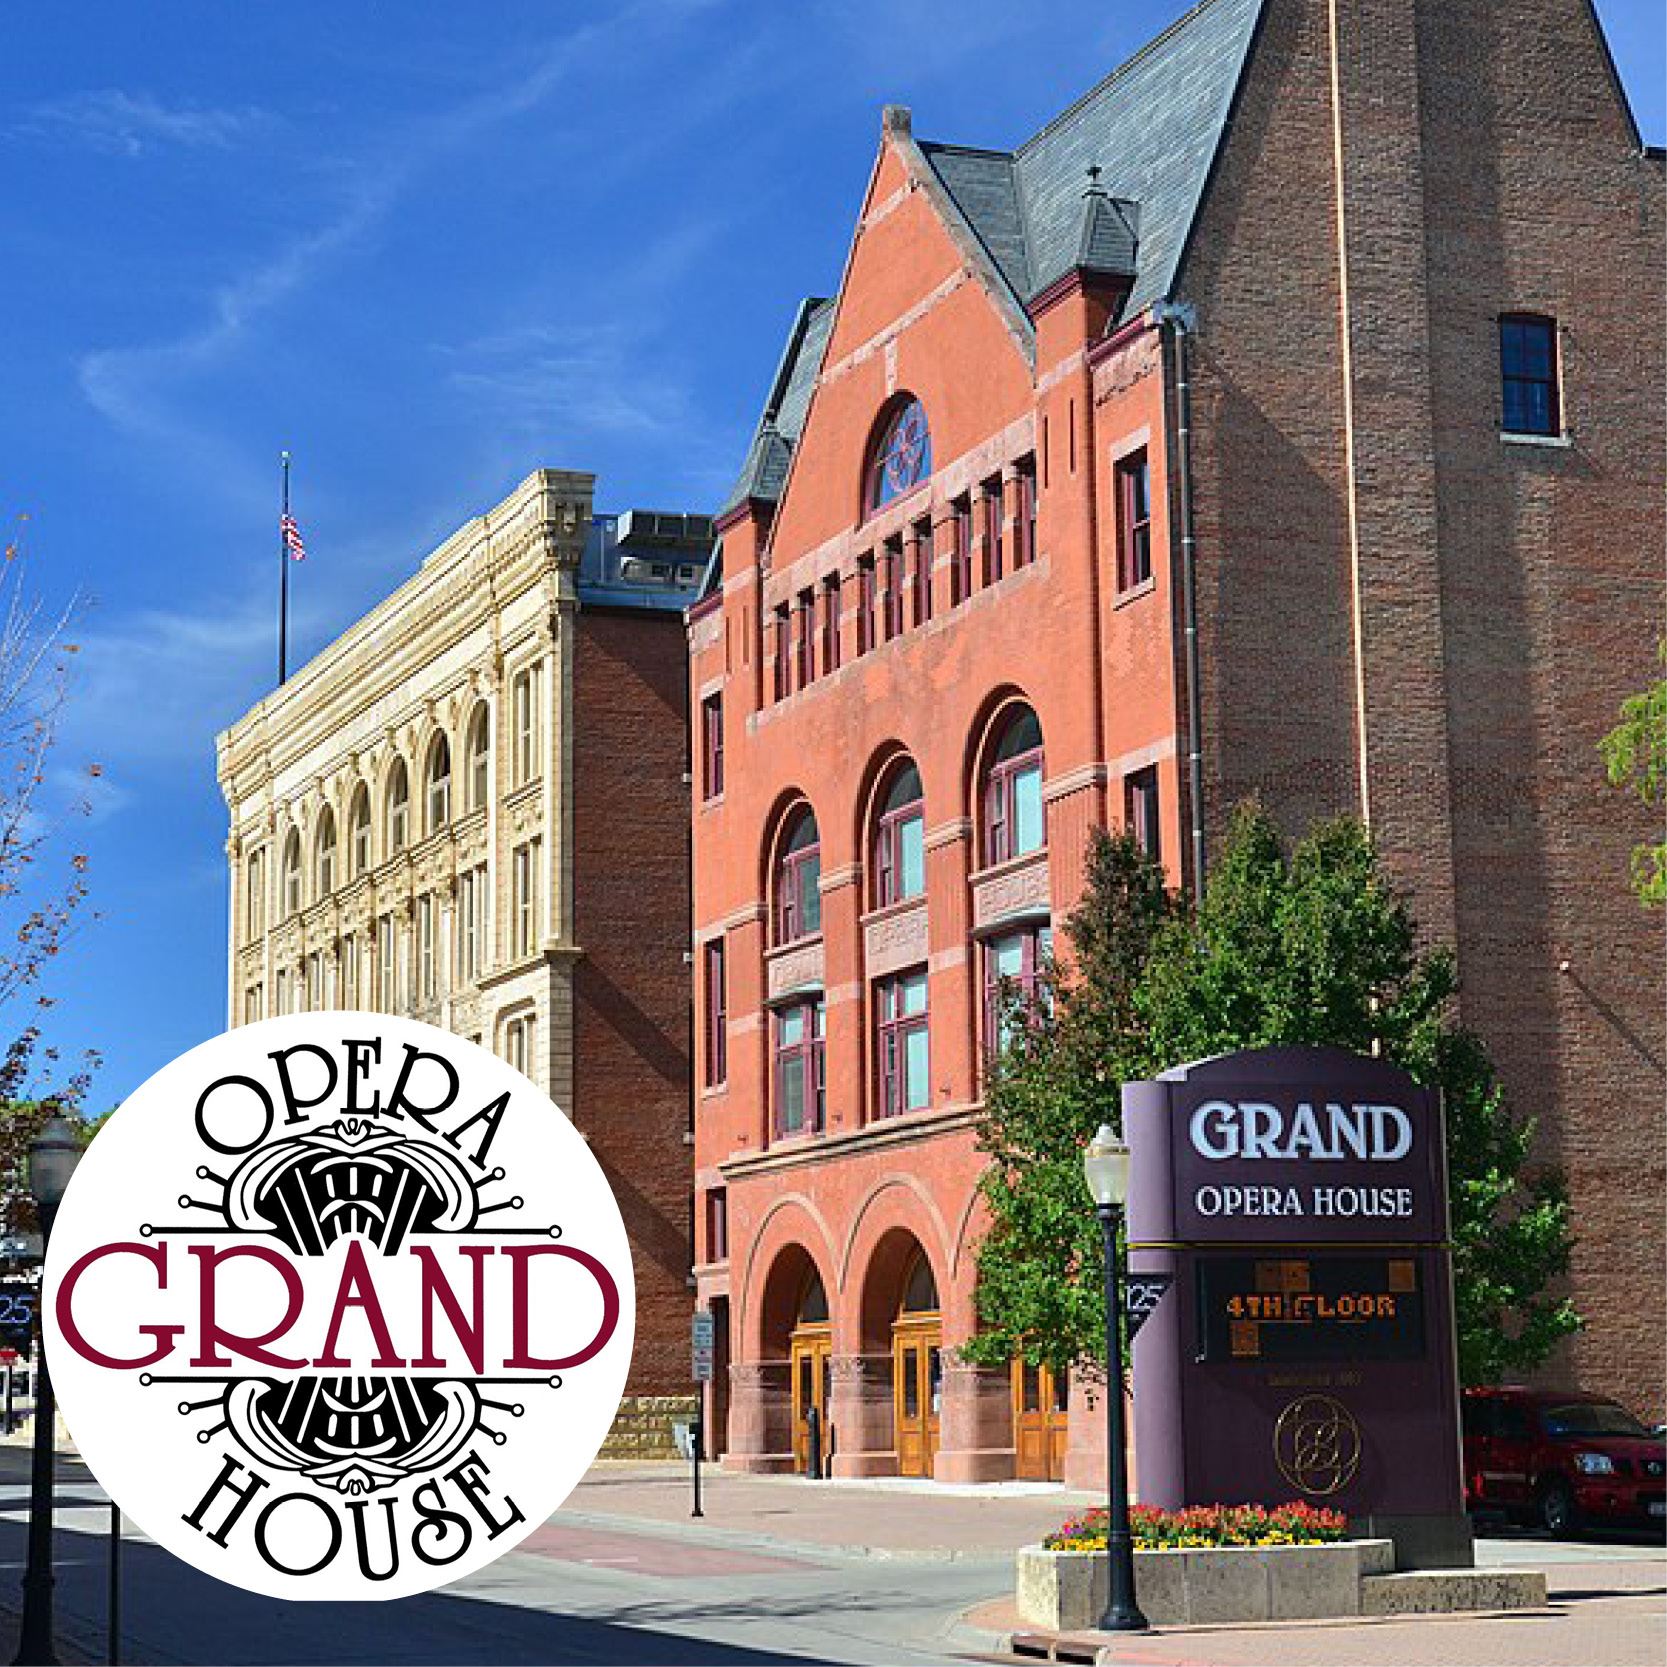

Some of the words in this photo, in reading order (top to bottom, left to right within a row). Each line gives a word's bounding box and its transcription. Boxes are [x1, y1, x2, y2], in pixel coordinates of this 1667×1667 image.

[1190, 1101, 1412, 1160] GRAND
[1196, 1186, 1304, 1216] OPERA
[1313, 1186, 1412, 1216] HOUSE
[1227, 1296, 1282, 1318] 4TH
[1294, 1296, 1396, 1319] FLOOR
